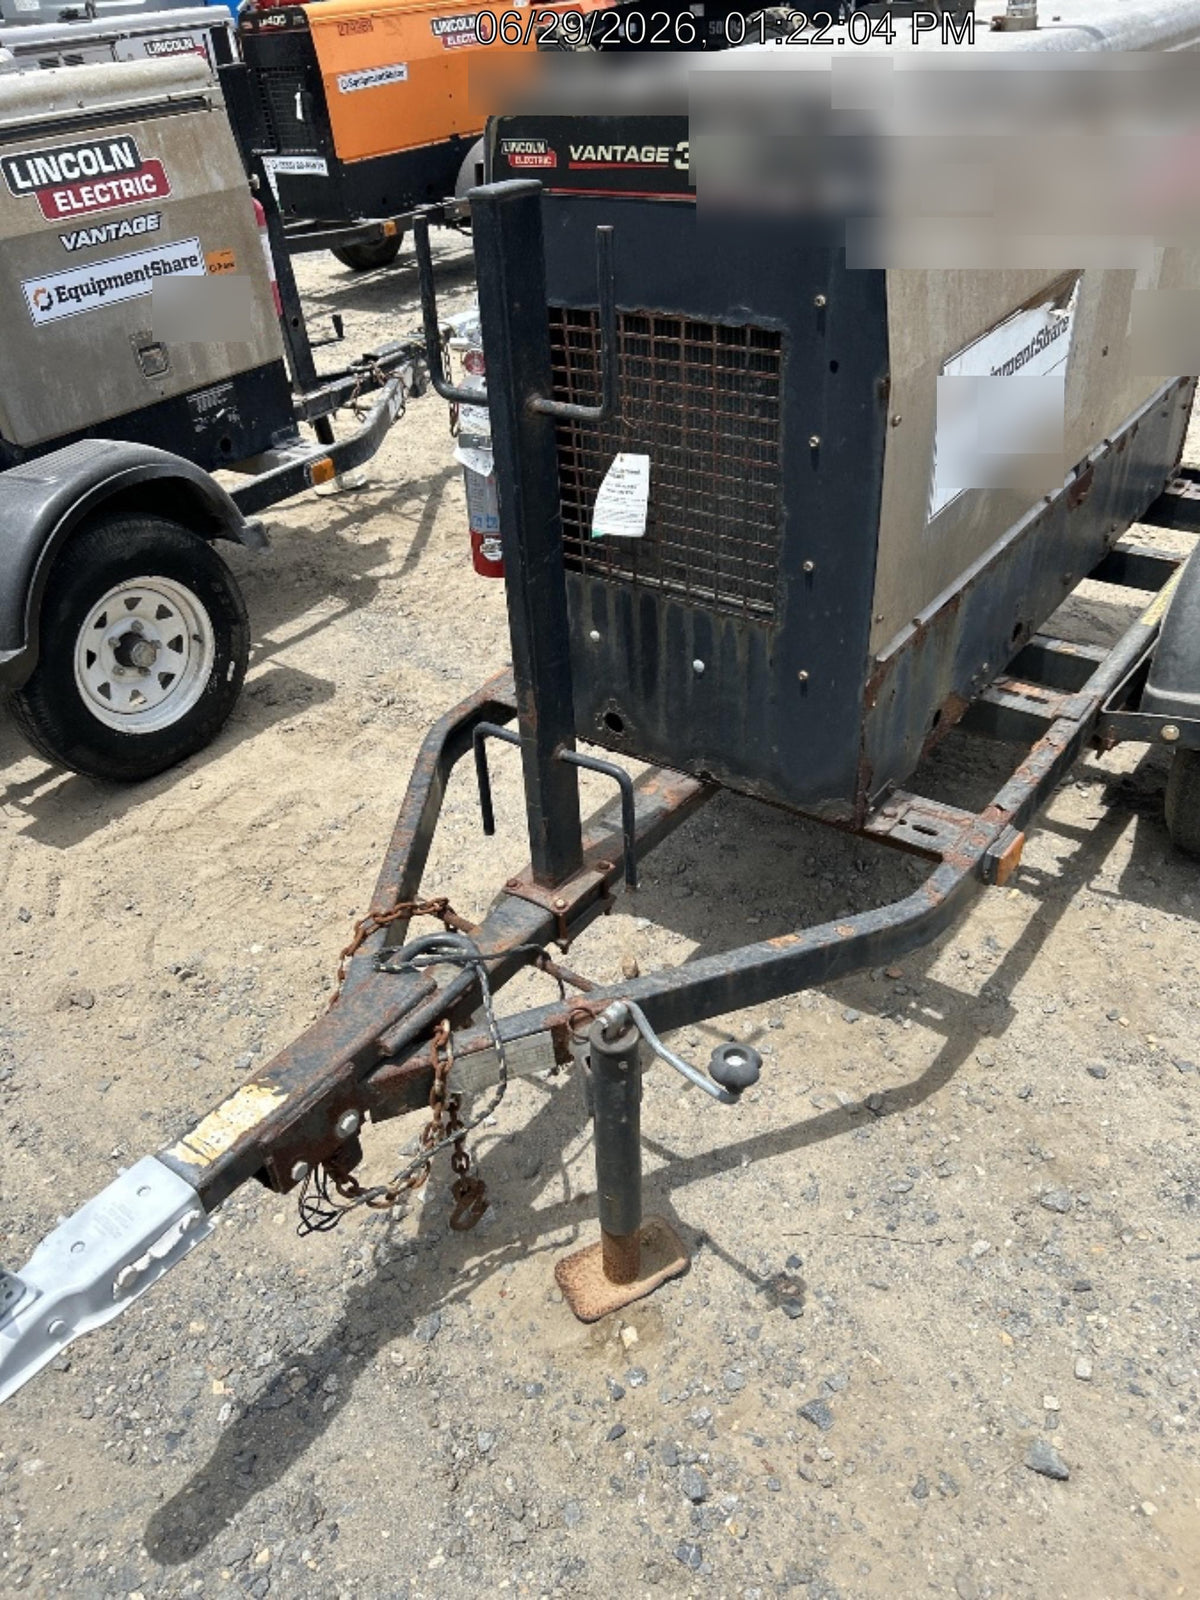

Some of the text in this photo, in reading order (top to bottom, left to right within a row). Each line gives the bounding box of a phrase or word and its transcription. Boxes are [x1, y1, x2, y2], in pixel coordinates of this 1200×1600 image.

[146, 38, 194, 54] LINCOLN
[502, 141, 546, 154] LINCOLN
[514, 155, 552, 165] ELECTRIC
[568, 144, 671, 163] VANTAGE
[9, 142, 136, 189] LINCOLN
[53, 174, 158, 212] ELECTRIC
[59, 212, 162, 251] VANTAGE
[55, 253, 199, 303] EquipmentShare
